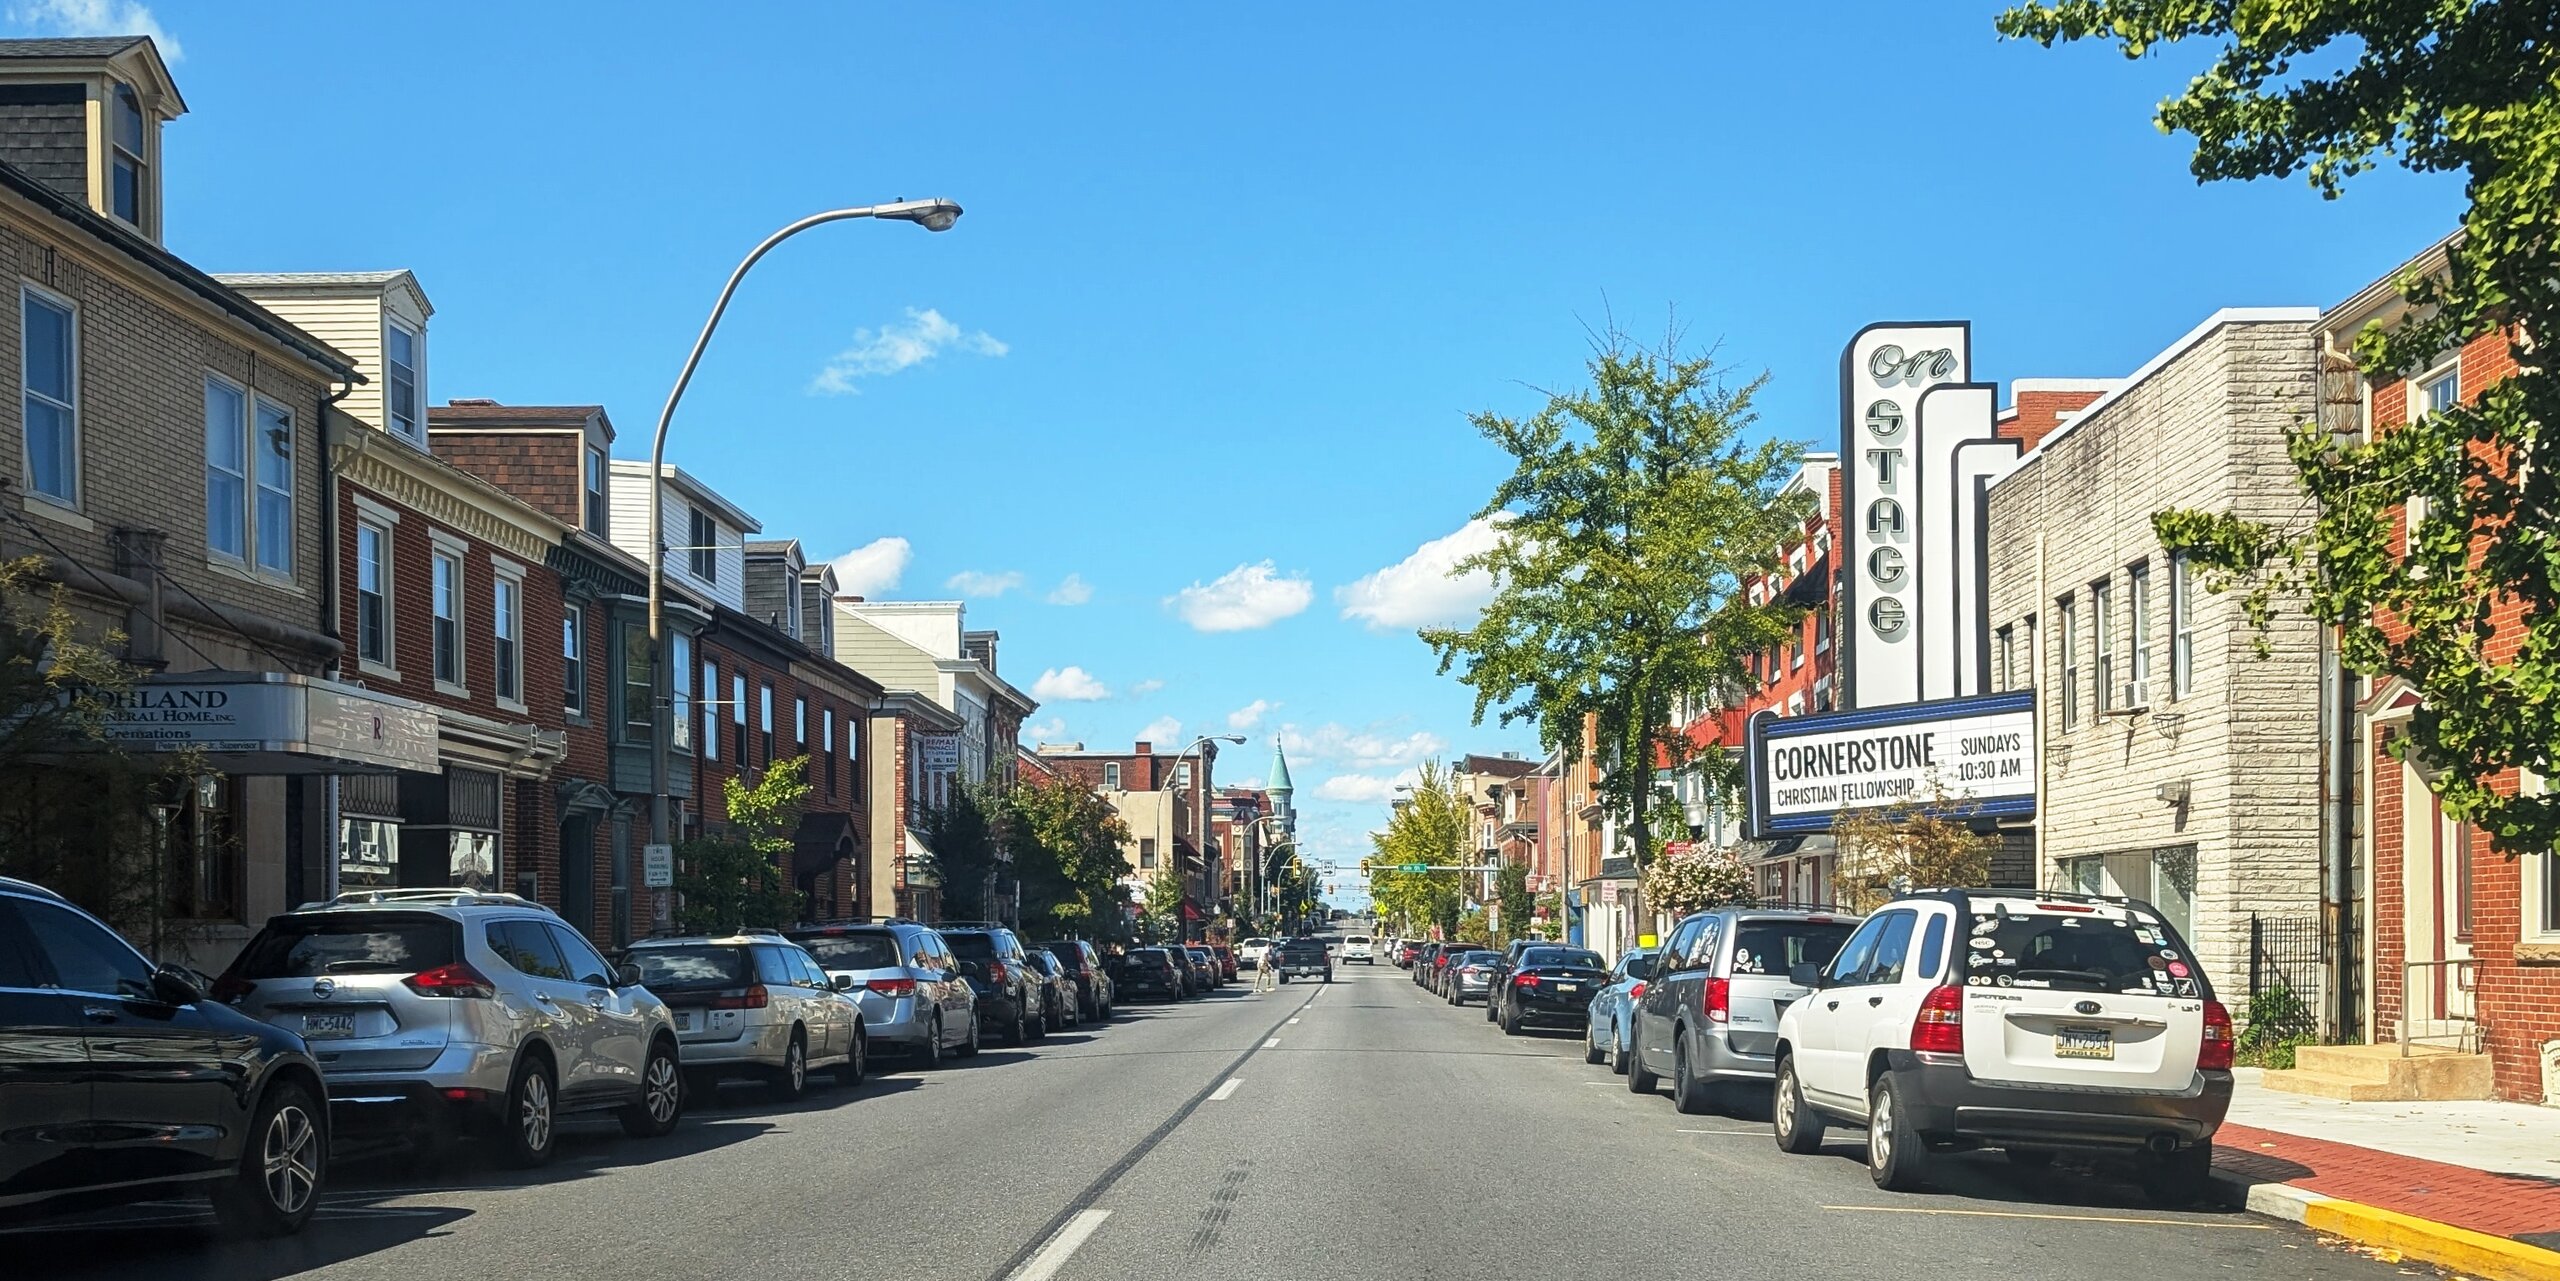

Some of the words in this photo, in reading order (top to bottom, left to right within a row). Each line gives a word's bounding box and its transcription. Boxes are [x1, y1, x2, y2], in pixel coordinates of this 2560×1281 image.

[1868, 344, 1952, 379] On
[1866, 399, 1905, 633] STAGE
[103, 727, 191, 739] Cremations
[373, 716, 382, 740] R
[1775, 732, 1935, 781] CORNERSTONE
[1961, 733, 2020, 756] SUNDAYS
[1958, 760, 1995, 781] 10:30
[2000, 757, 2021, 778] AM
[1777, 784, 1837, 807] CHRISTIAN
[1841, 778, 1914, 802] FELLOWSHIP
